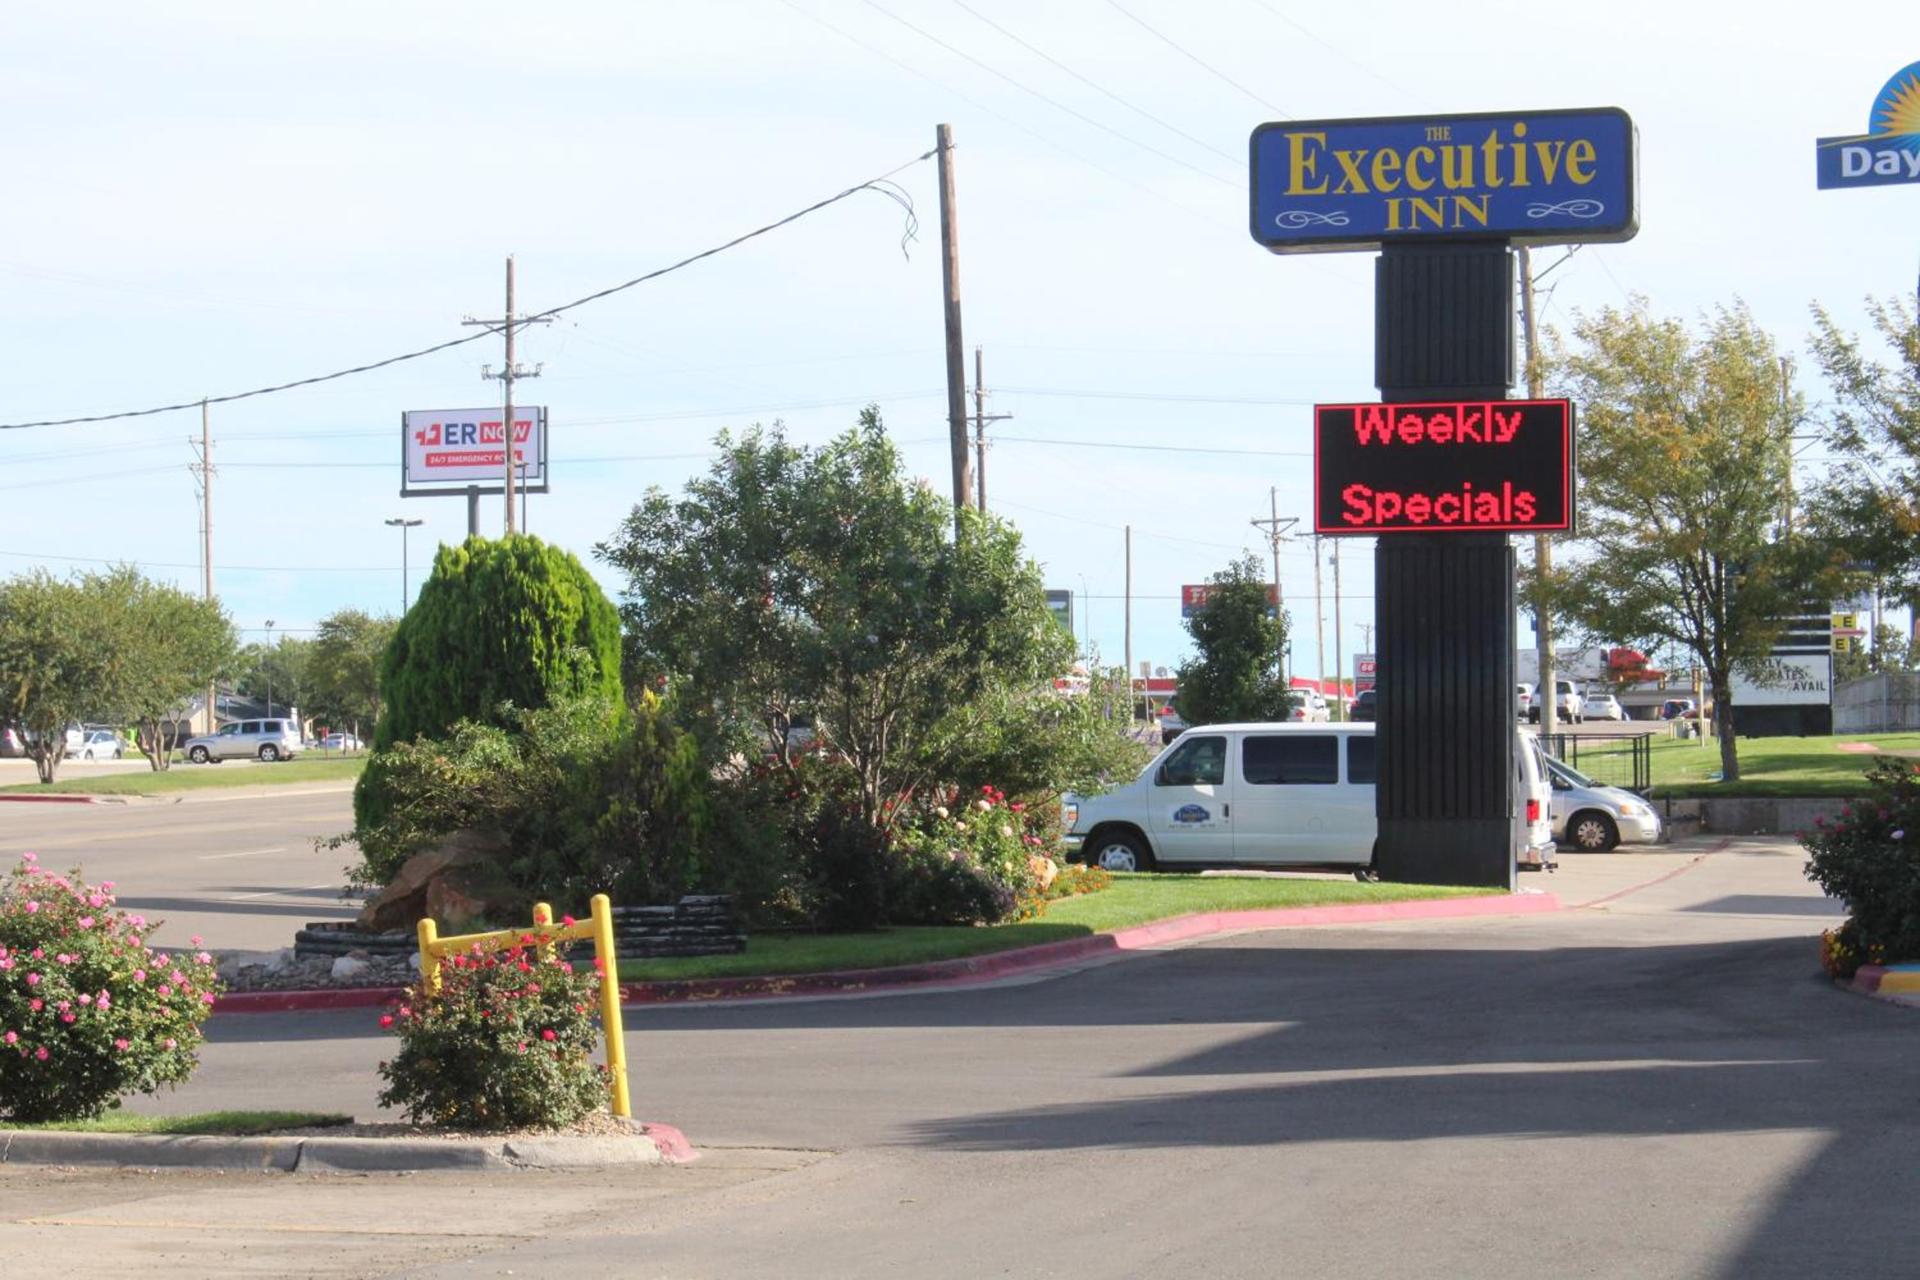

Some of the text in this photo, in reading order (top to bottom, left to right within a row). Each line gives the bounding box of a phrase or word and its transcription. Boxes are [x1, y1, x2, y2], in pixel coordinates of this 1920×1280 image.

[1424, 126, 1452, 142] THE
[1283, 121, 1597, 196] Executive
[1384, 195, 1493, 231] INN
[445, 423, 477, 445] ER
[1354, 402, 1523, 445] Weekly
[447, 455, 493, 463] EMERGENCY
[1342, 482, 1537, 525] Specials
[1792, 681, 1826, 692] AVAIL
